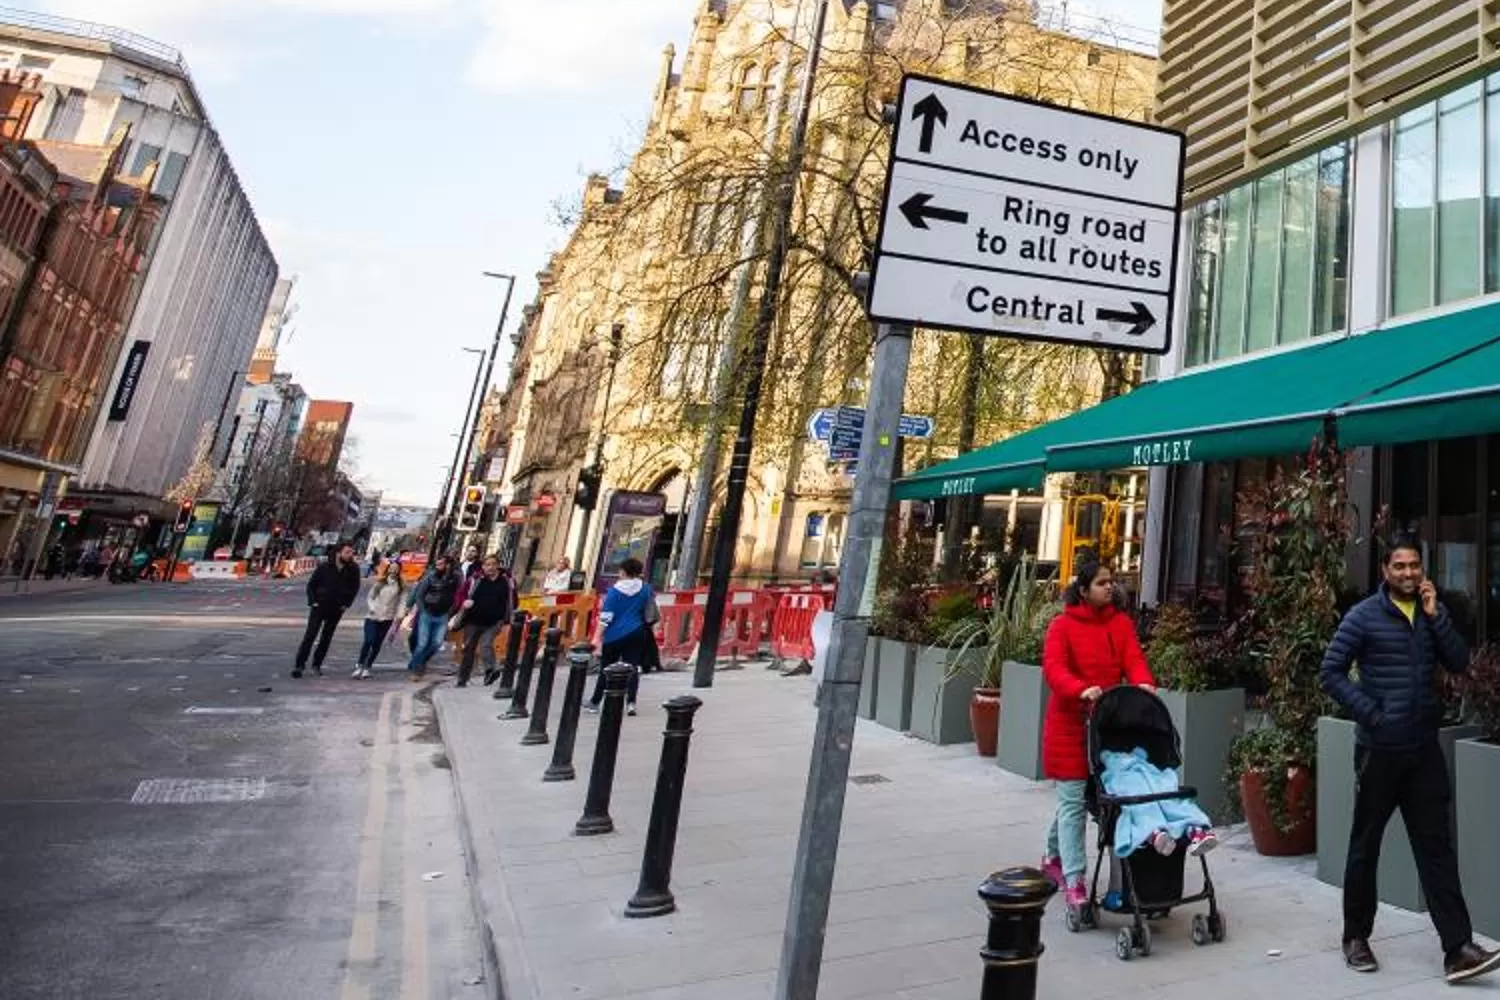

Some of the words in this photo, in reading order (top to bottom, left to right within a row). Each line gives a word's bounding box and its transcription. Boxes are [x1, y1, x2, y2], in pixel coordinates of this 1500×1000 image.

[960, 119, 1067, 162] Access
[1079, 146, 1139, 180] only
[1003, 195, 1071, 235] Ring
[1081, 215, 1147, 244] road
[975, 228, 1007, 255] to
[1019, 236, 1057, 263] all
[1068, 246, 1162, 279] routes
[966, 286, 1086, 325] Central
[1132, 440, 1193, 465] MOTLEY
